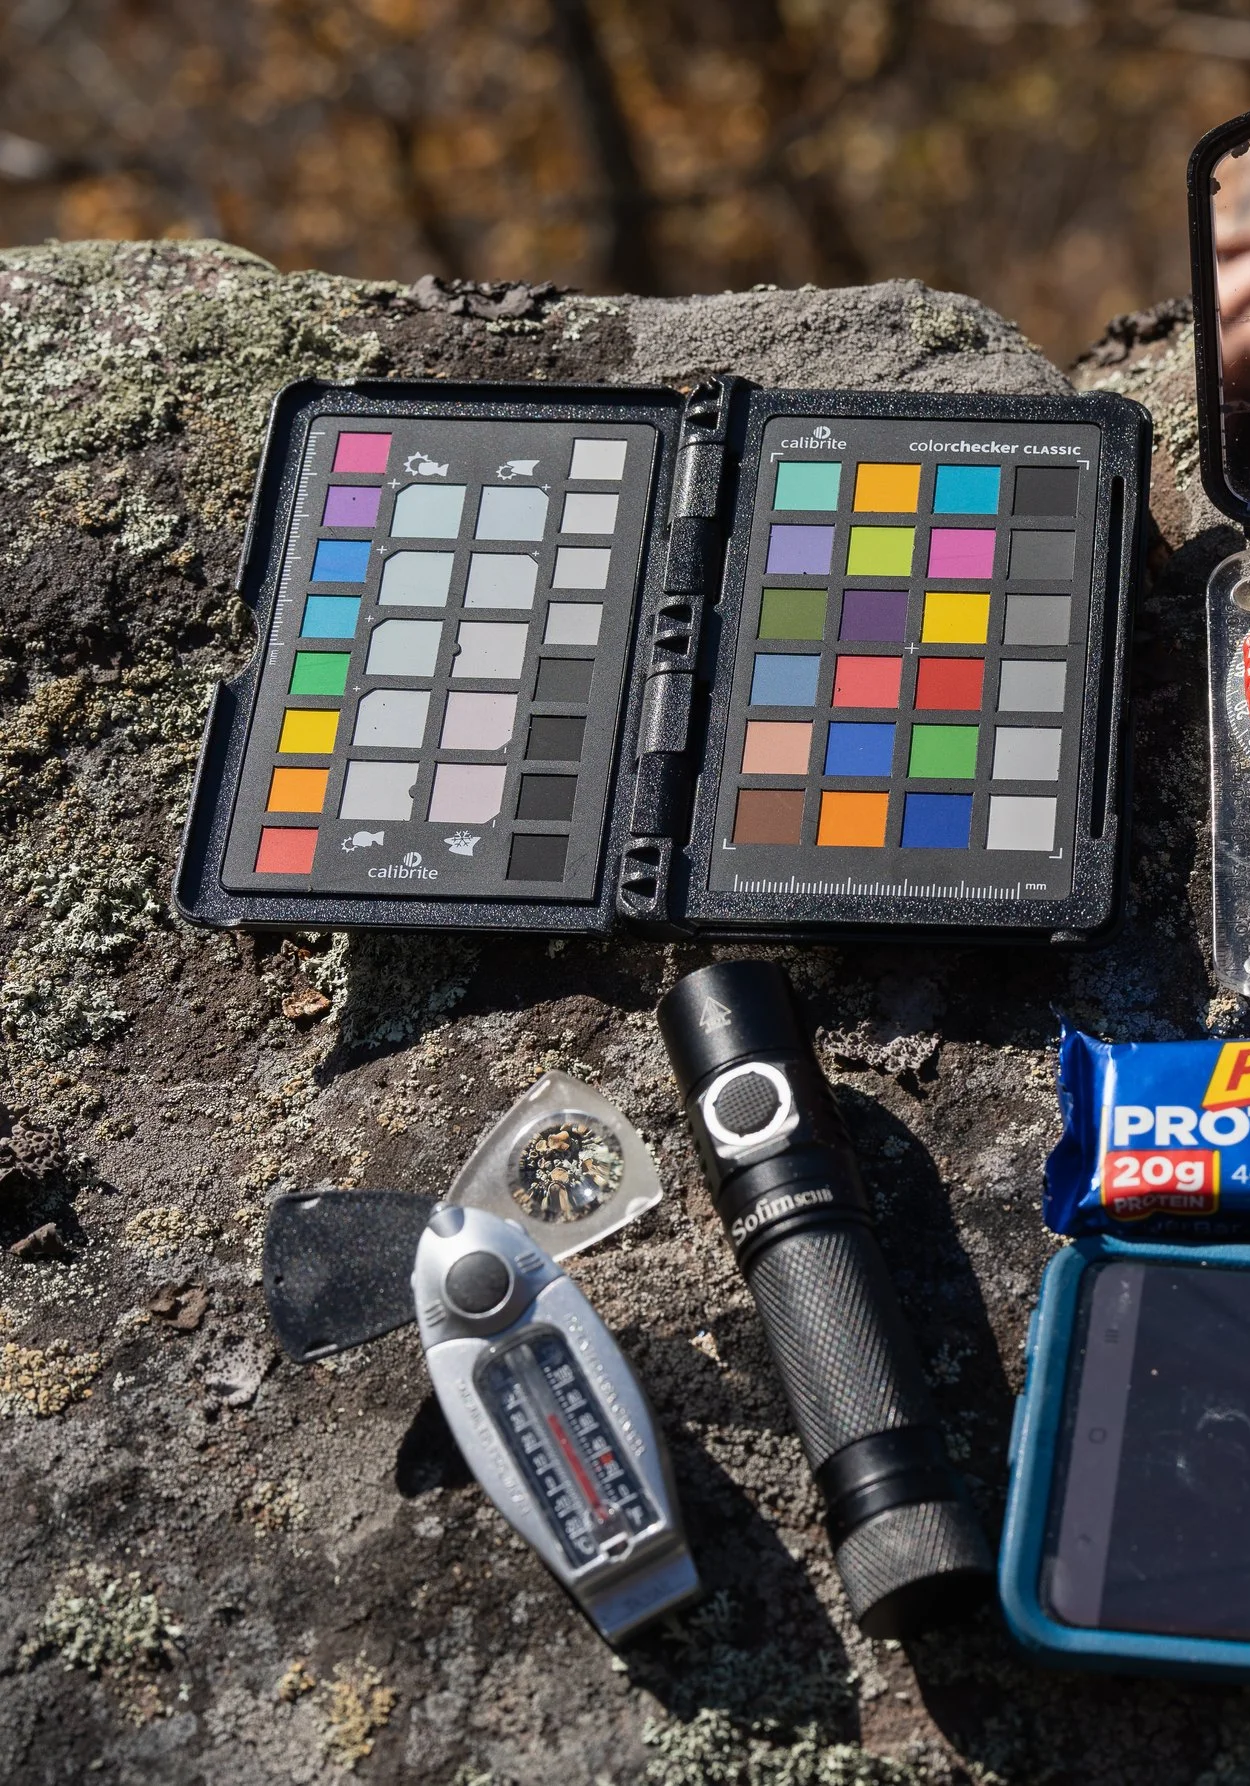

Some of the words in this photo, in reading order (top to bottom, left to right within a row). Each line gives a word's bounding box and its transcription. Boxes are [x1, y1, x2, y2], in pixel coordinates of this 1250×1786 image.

[781, 437, 848, 451] calibrite
[909, 439, 1019, 455] colorchecker
[1023, 445, 1082, 456] CLASSIC
[1234, 699, 1249, 721] 20
[368, 864, 439, 880] calibrite
[1025, 883, 1047, 891] mm
[1112, 1155, 1206, 1192] 20g
[1113, 1191, 1204, 1215] PROTEIN
